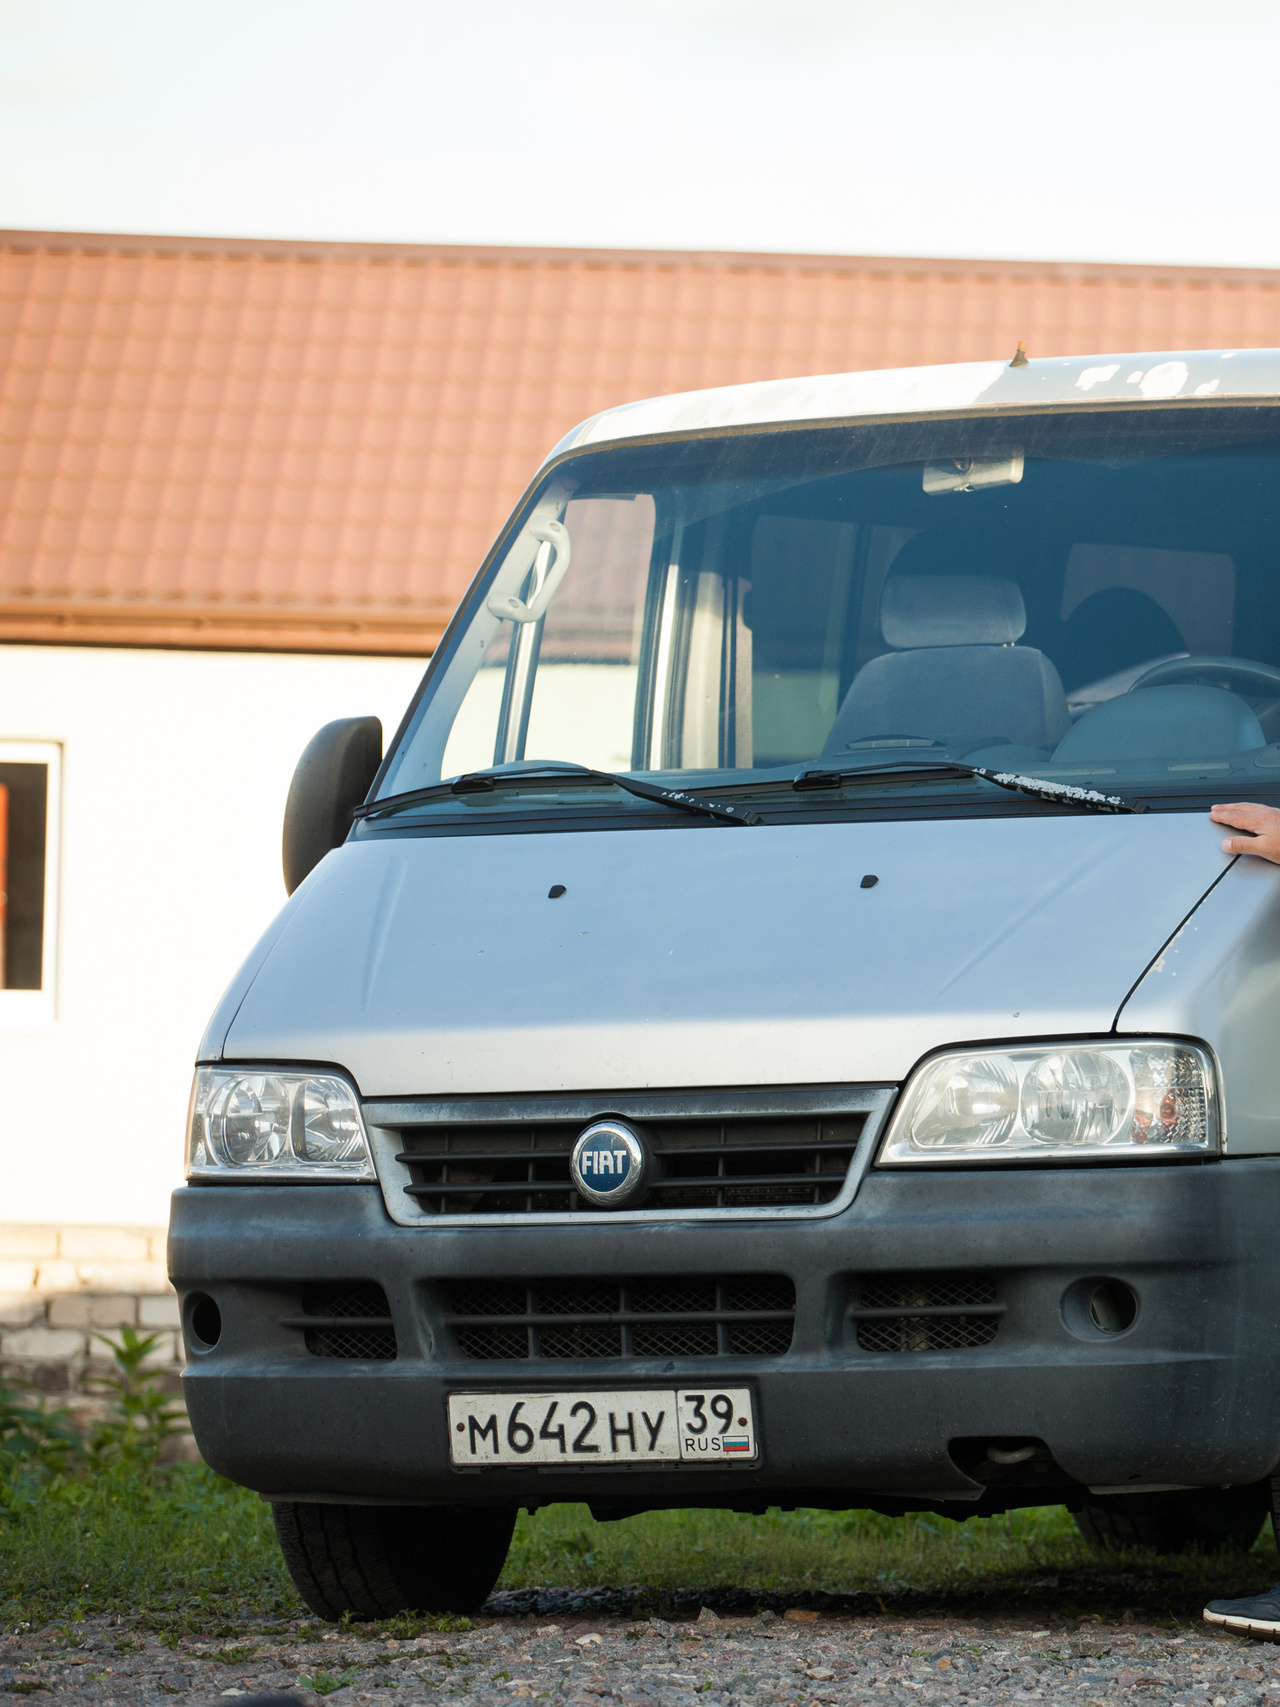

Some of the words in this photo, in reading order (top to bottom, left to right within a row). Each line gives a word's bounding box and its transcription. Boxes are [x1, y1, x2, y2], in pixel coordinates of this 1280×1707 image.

[582, 1150, 626, 1175] FIAT
[684, 1395, 734, 1434] 39
[685, 1437, 721, 1452] RUS
